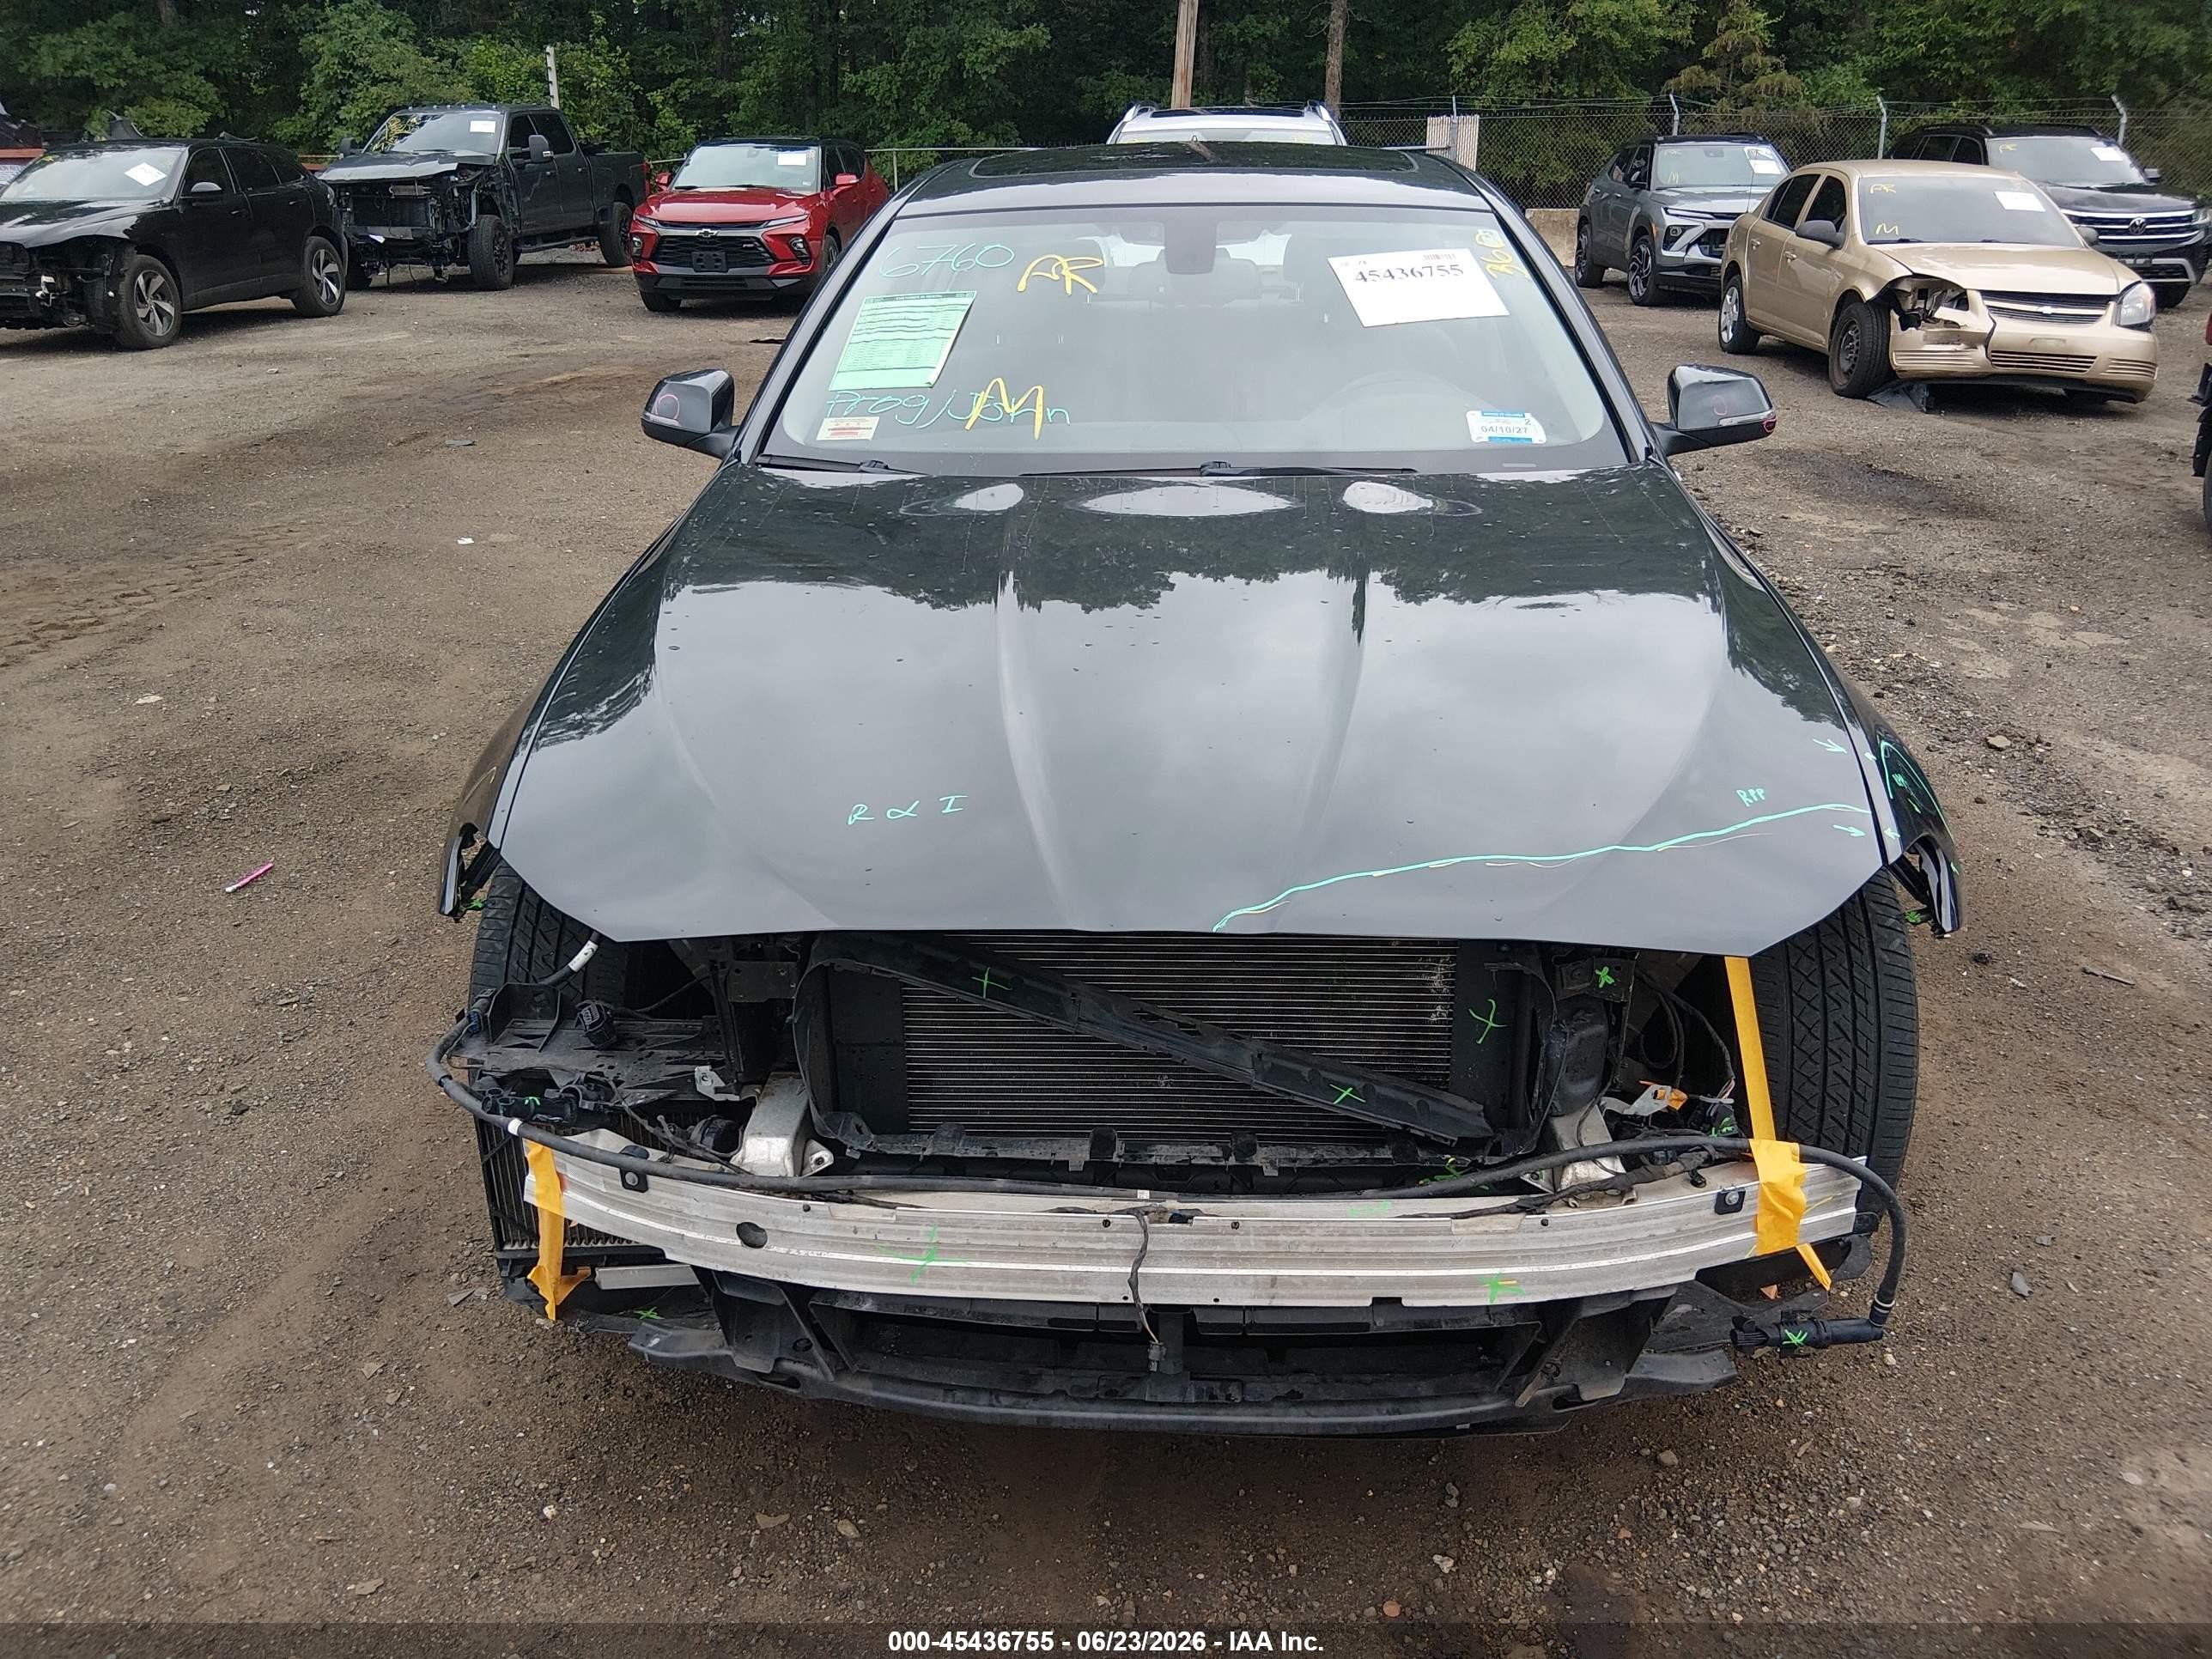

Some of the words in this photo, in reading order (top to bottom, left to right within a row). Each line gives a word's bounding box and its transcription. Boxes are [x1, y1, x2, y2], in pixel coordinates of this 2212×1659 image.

[1875, 222, 1899, 235] M
[879, 243, 1015, 278] 6760
[1355, 264, 1464, 283] 45436755
[1480, 425, 1528, 434] 04/10/27
[848, 803, 875, 825] R
